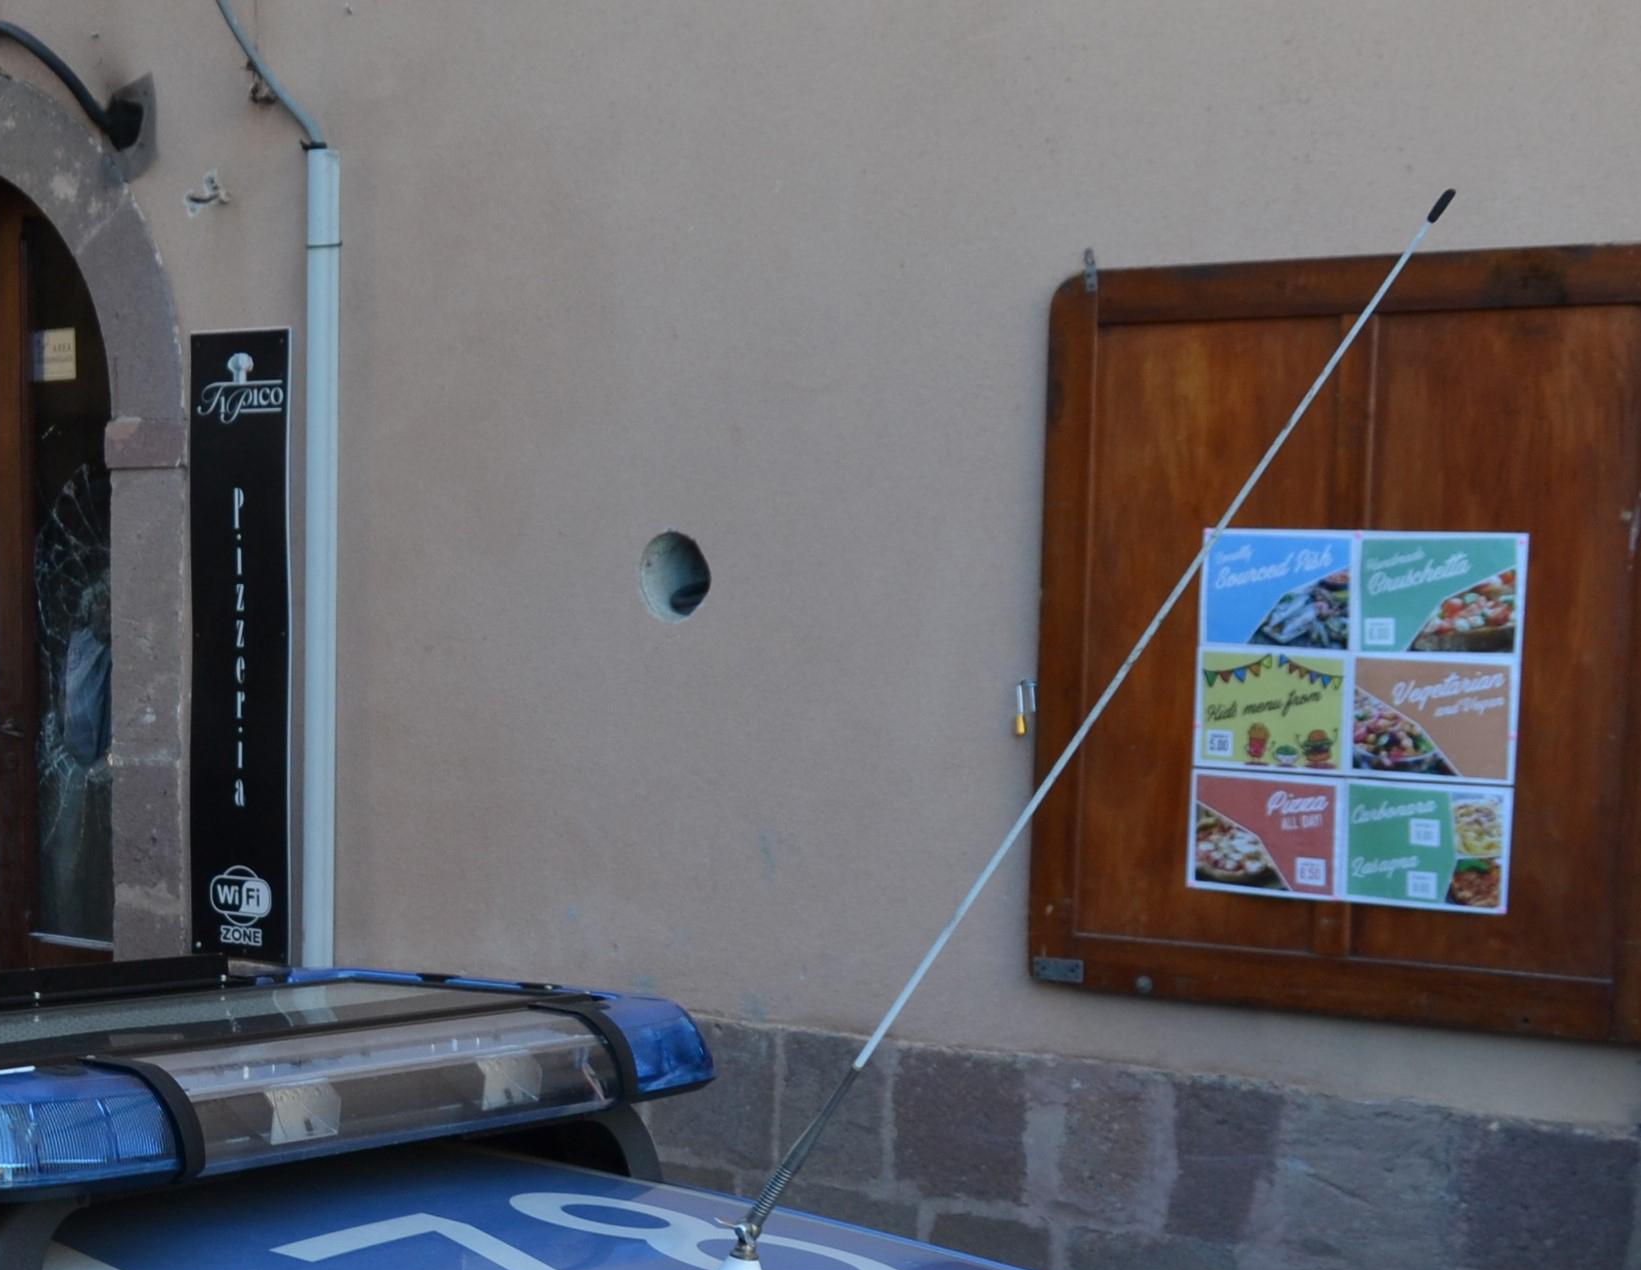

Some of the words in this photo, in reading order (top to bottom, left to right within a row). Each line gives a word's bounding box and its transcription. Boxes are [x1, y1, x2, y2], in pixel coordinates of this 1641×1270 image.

[1216, 552, 1295, 589] Sourced
[1294, 544, 1334, 573] Fish
[1367, 551, 1473, 596] Bruschetta
[233, 487, 246, 807] Pizzeria
[1206, 701, 1238, 722] Kids
[1242, 699, 1282, 715] menu
[1281, 689, 1322, 718] from
[1391, 672, 1506, 711] Vegetarian
[1265, 790, 1330, 817] Pizza
[1281, 816, 1299, 831] ALL
[220, 925, 262, 946] ZONE
